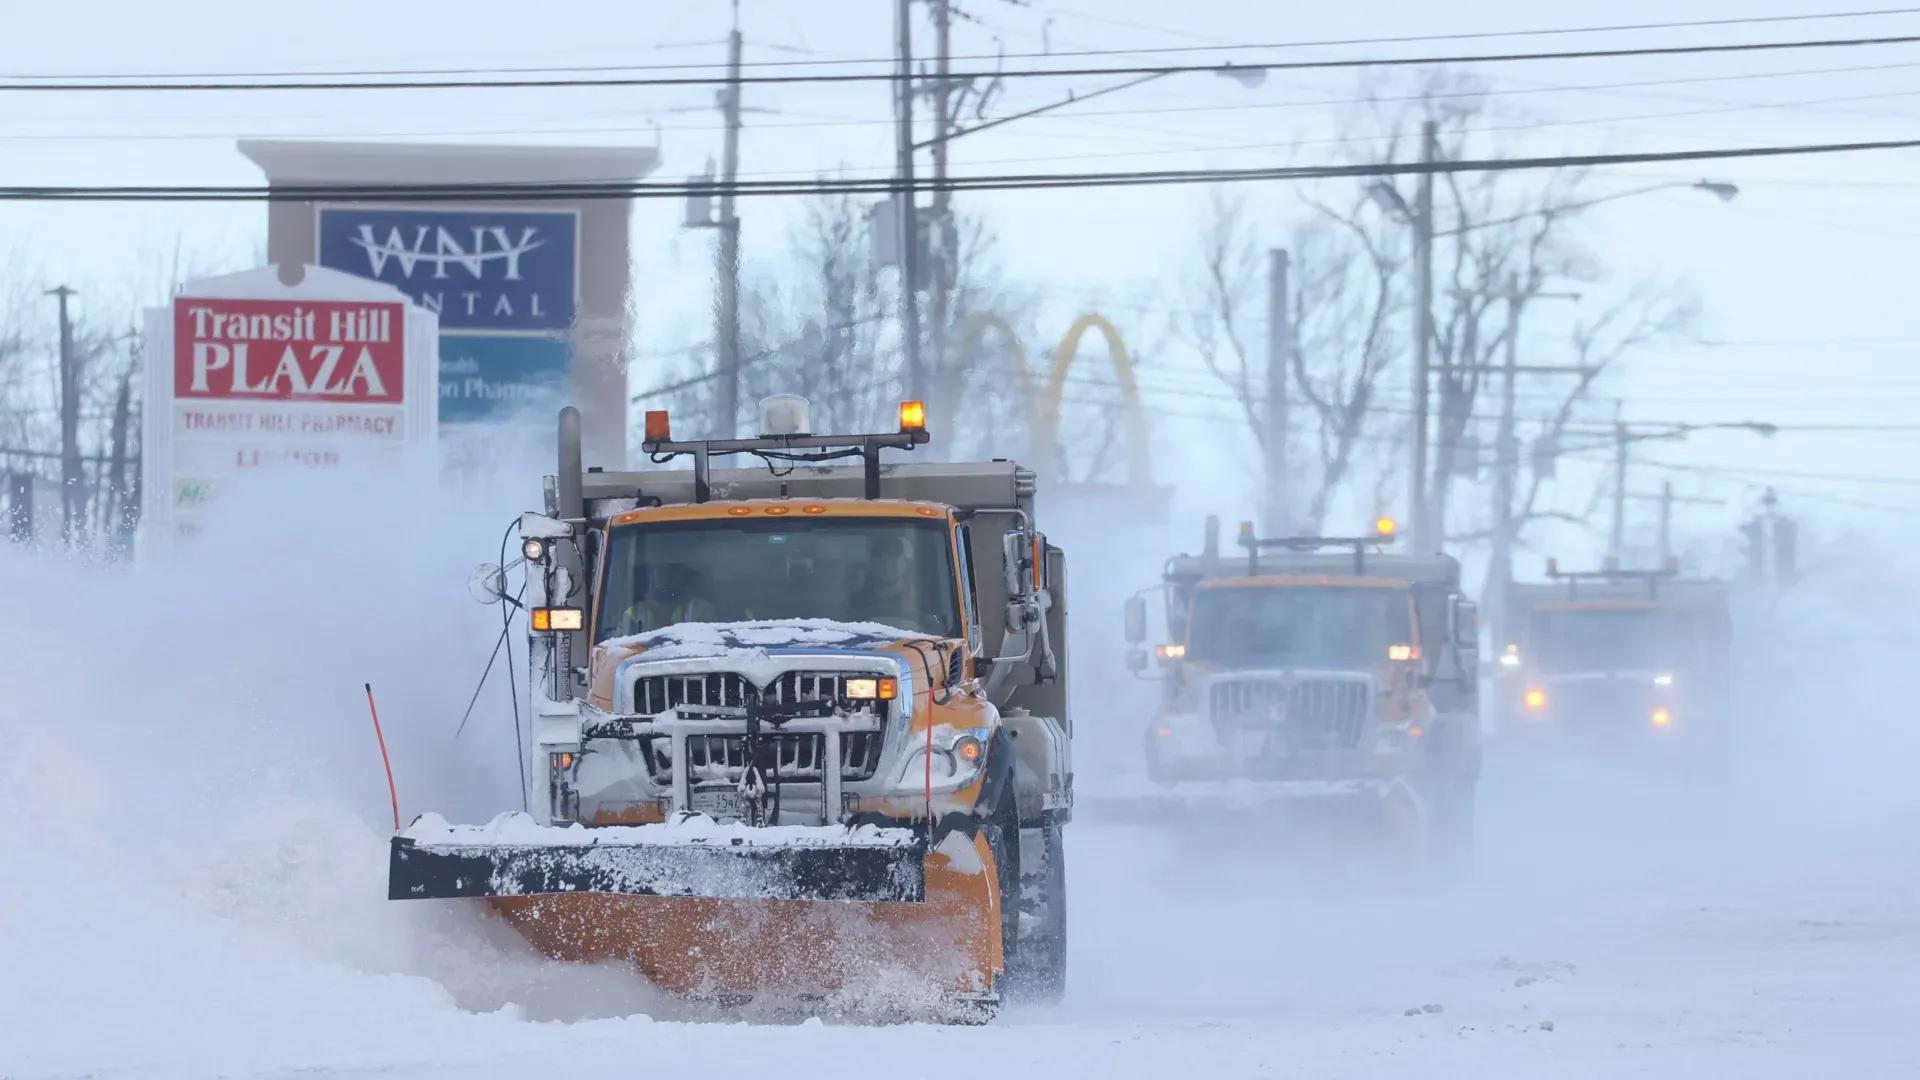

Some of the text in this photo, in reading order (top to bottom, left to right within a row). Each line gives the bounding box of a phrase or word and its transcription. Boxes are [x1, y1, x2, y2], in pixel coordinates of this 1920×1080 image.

[356, 224, 540, 280] WNY
[421, 291, 546, 317] NTAL
[188, 306, 391, 343] Transit Hill
[190, 342, 388, 397] PLAZA
[464, 377, 535, 399] Pharm
[183, 412, 397, 434] TRANSIT HILL PHARMACY
